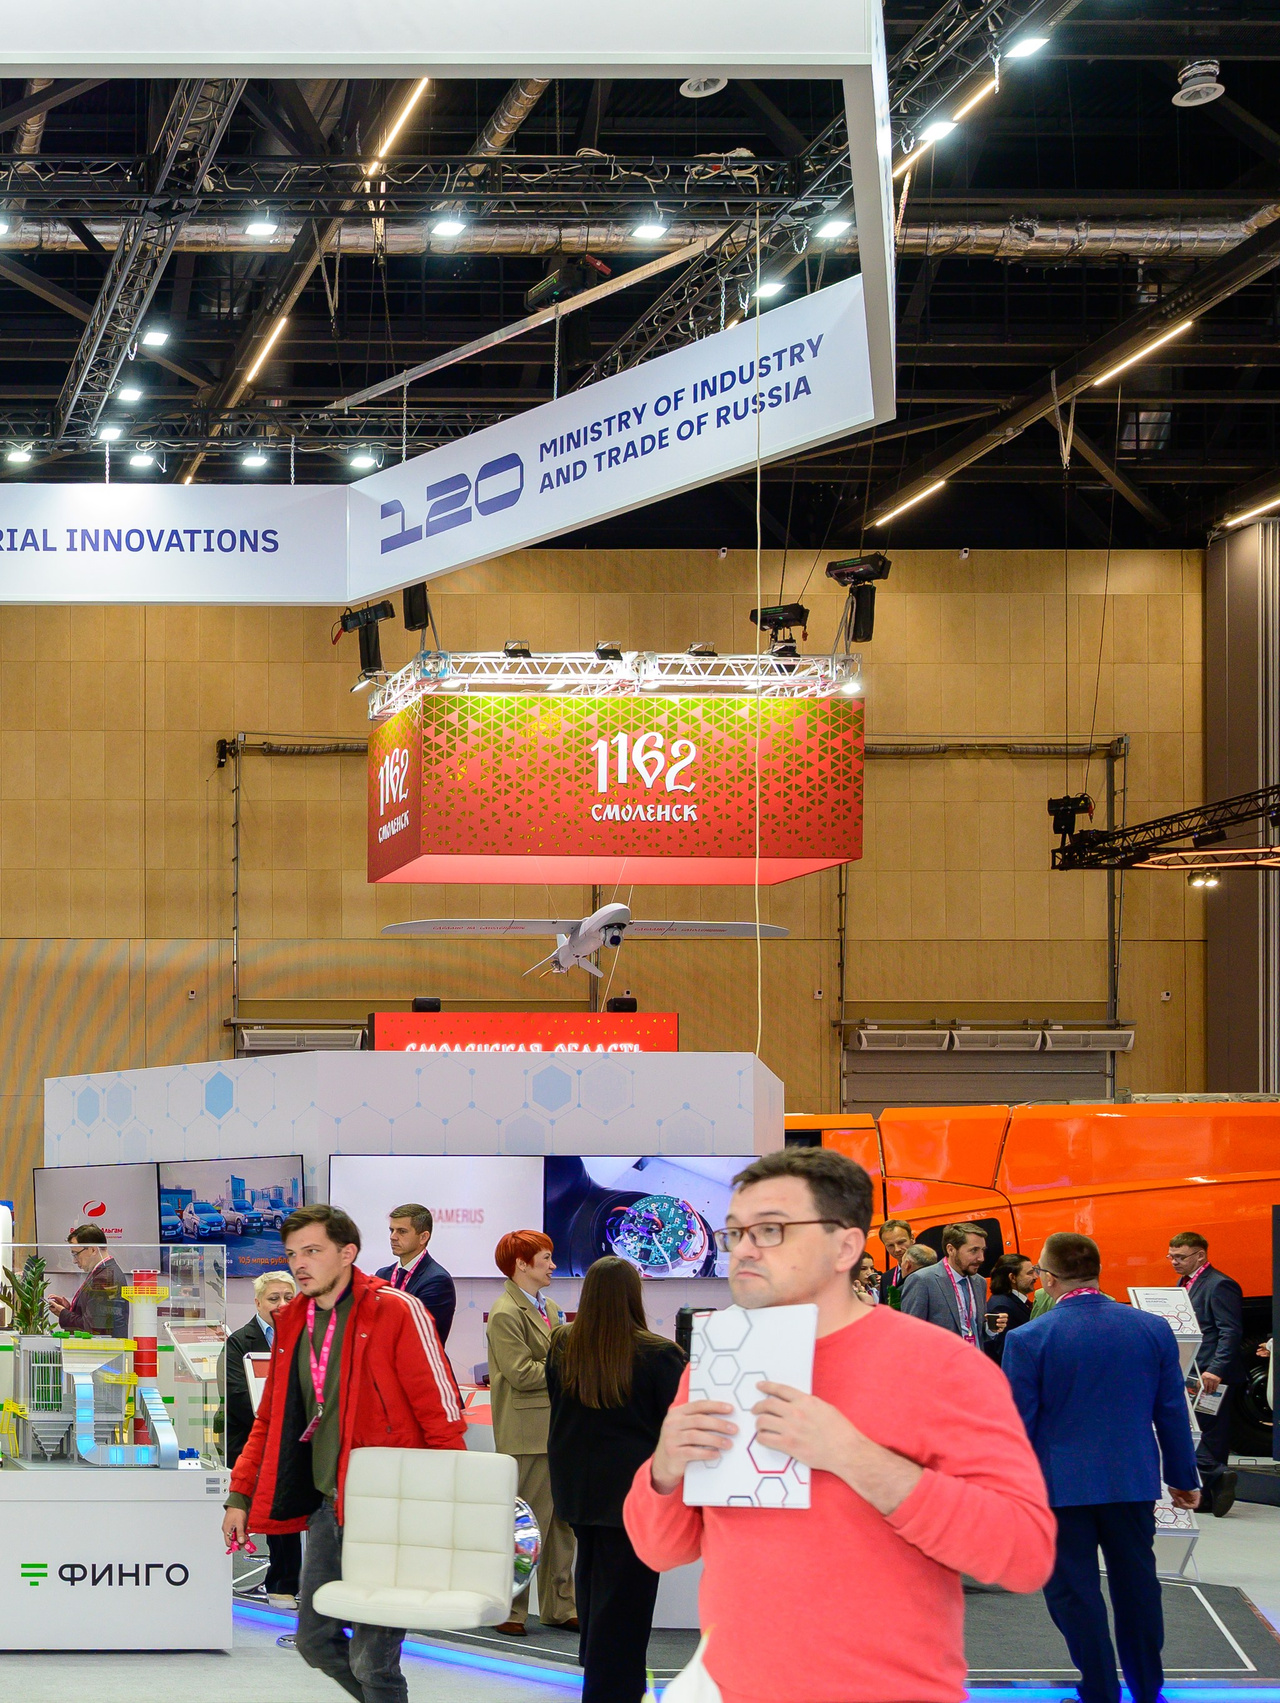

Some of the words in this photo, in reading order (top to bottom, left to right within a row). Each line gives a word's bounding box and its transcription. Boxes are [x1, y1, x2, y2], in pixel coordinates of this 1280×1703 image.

[539, 402, 647, 463] MINISTRY
[653, 387, 686, 417] OF
[692, 333, 824, 406] INDUSTRY
[539, 457, 588, 494] AND
[593, 432, 670, 473] TRADE
[676, 412, 710, 441] OF
[716, 375, 812, 428] RUSSIA
[380, 452, 524, 555] 120
[66, 528, 280, 553] INNOVATIONS
[378, 747, 409, 817] 1162
[590, 731, 697, 793] 1162
[378, 810, 410, 844] СМОЛЕНСК
[591, 804, 698, 822] СМОЛЕНСК
[238, 1256, 251, 1265] 10,5
[251, 1257, 269, 1265] млрд
[58, 1563, 189, 1586] ФИНГО
